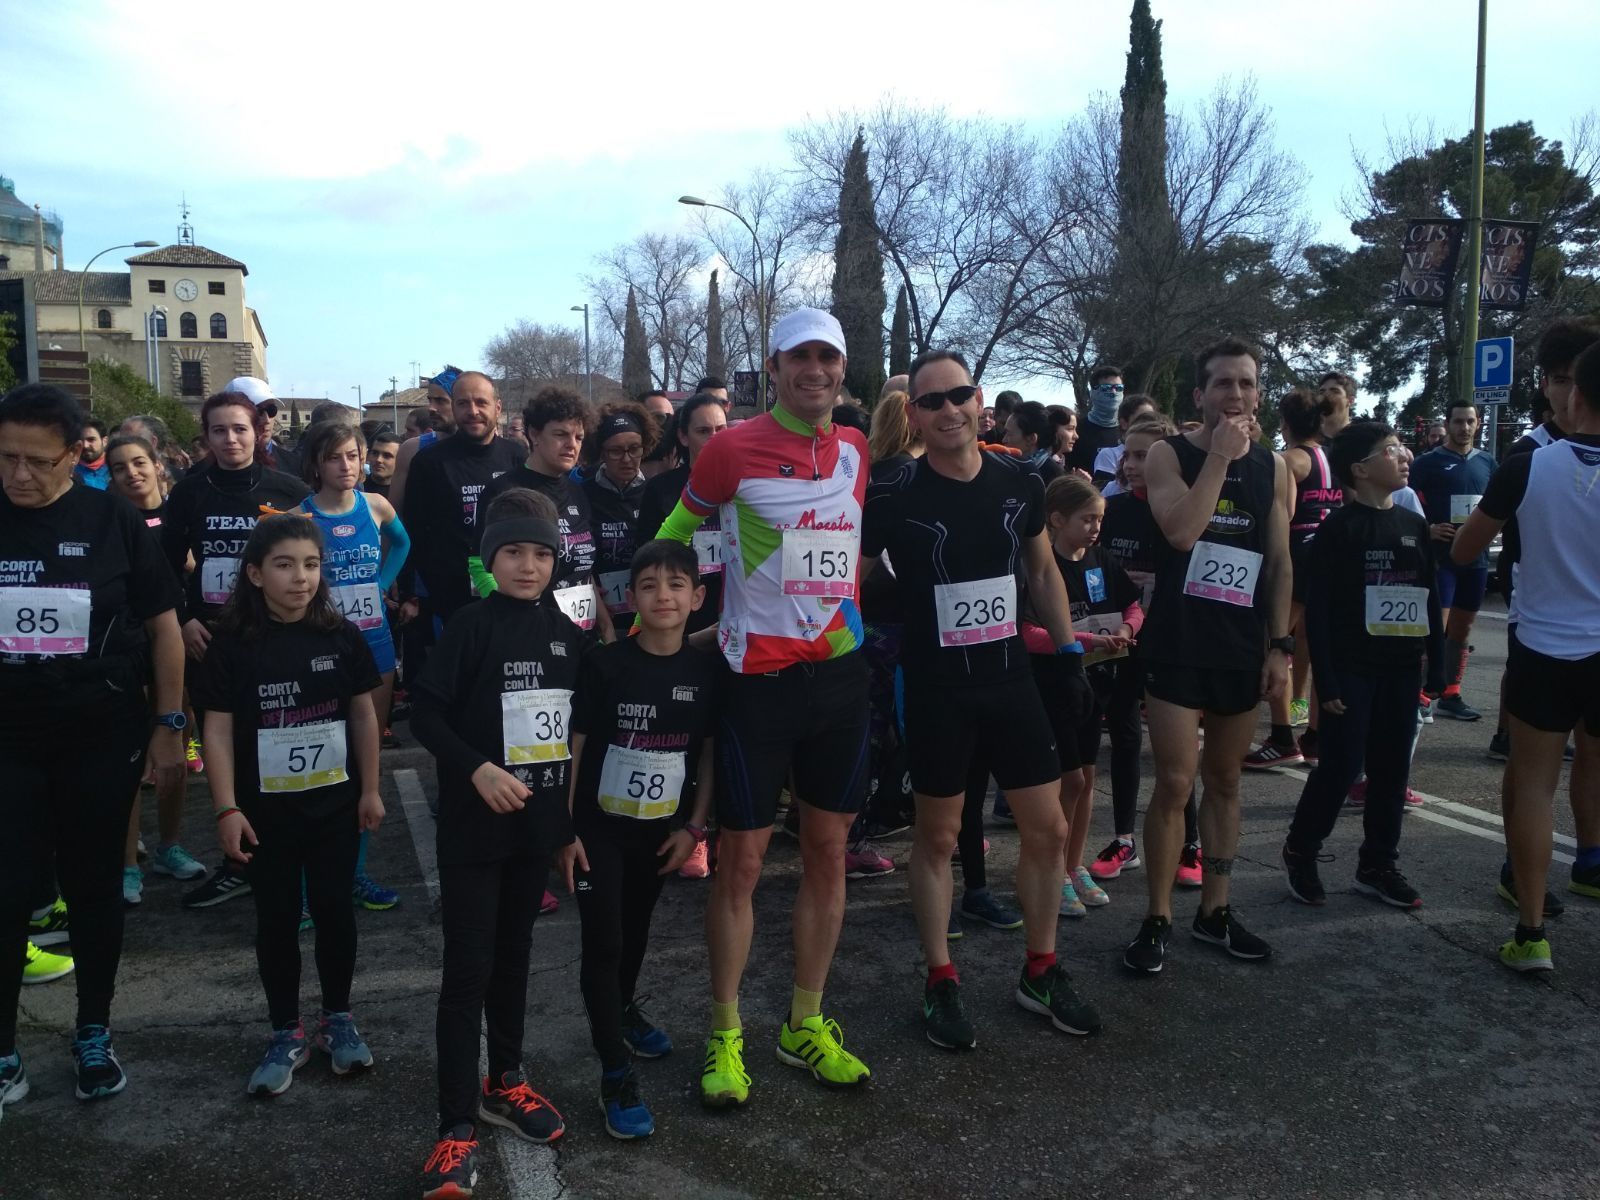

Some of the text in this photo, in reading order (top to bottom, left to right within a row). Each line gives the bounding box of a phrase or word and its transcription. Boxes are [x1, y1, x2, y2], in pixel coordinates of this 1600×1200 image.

[1410, 225, 1449, 242] CIS
[1488, 226, 1525, 246] CIS
[1485, 255, 1511, 273] NE
[1398, 279, 1446, 298] ROS
[1481, 283, 1521, 301] ROS
[1481, 344, 1504, 382] P
[1303, 489, 1343, 503] PINA
[206, 516, 259, 531] TEAM
[602, 522, 628, 531] CORTA
[1111, 537, 1140, 551] CORTA
[1365, 550, 1395, 560] CORTA
[0, 560, 45, 572] CORTA
[802, 550, 849, 579] 153
[1380, 560, 1392, 570] LA
[0, 572, 37, 583] CON LA
[1201, 560, 1248, 589] 232
[954, 596, 1006, 628] 236
[1070, 601, 1090, 611] ORTA
[1380, 601, 1418, 622] 220
[16, 607, 59, 634] 85
[503, 661, 544, 676] CORTA
[258, 681, 301, 698] CORTA
[504, 675, 540, 690] CON LA
[260, 695, 296, 710] CON LA
[617, 703, 657, 719] CORTA
[535, 710, 564, 741] 38
[618, 718, 649, 731] CON LA
[288, 743, 325, 773] 57
[627, 770, 665, 801] 58
